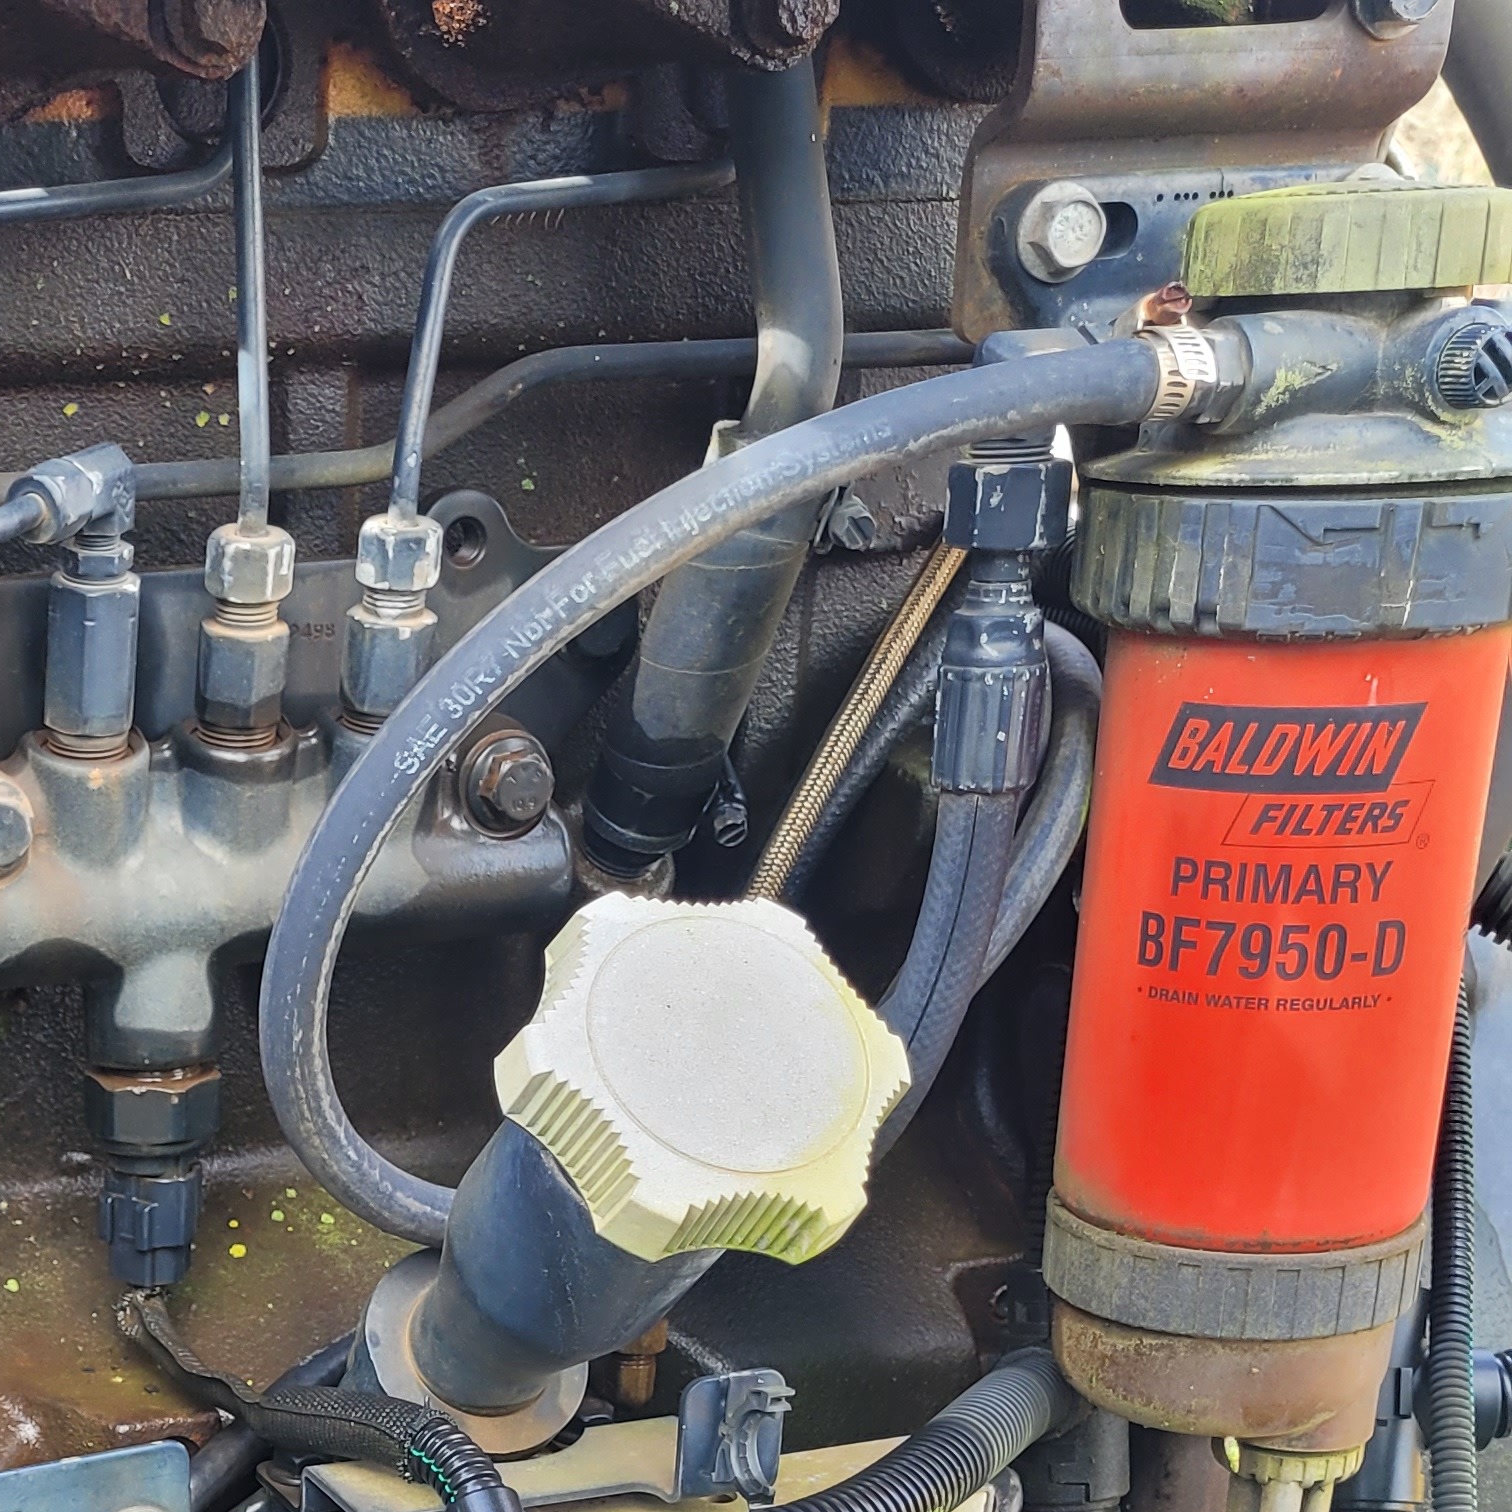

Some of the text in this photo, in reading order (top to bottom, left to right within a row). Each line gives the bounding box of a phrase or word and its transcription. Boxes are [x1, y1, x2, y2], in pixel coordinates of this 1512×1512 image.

[1167, 717, 1407, 777] BALDWIN
[1248, 800, 1411, 837] FILTERS
[1170, 856, 1395, 905] PRIMARY
[1136, 910, 1408, 982] BF7950-D
[1147, 986, 1382, 1013] DRAIN WATER REGULARLY
